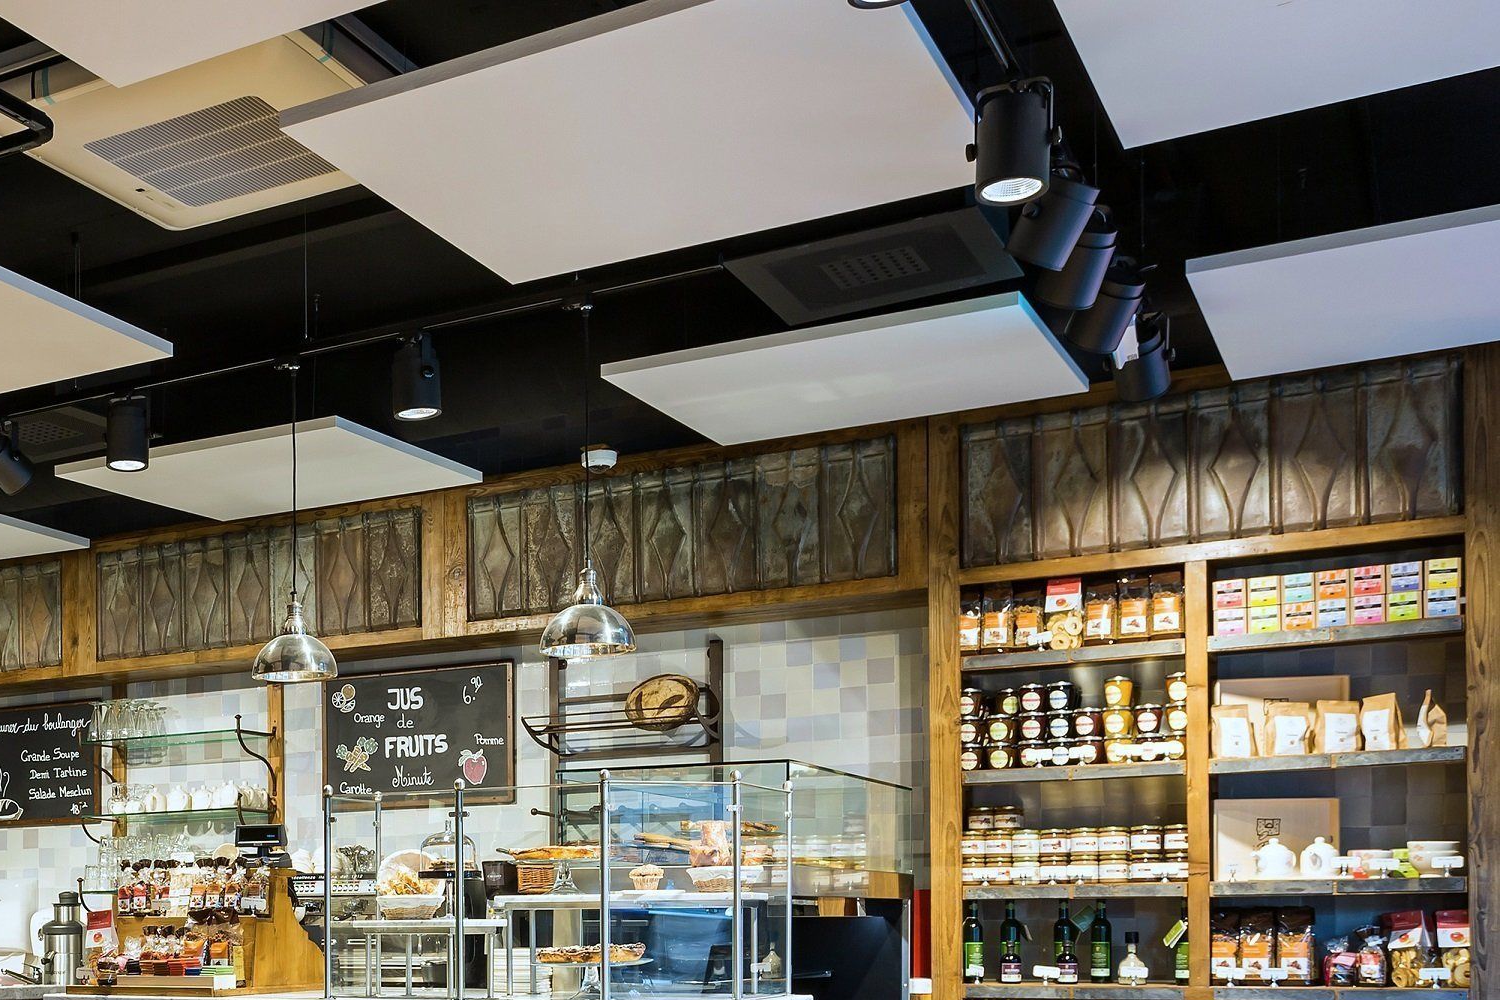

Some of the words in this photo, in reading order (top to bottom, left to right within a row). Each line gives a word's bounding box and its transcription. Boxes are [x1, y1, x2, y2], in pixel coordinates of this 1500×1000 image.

[387, 687, 424, 710] JUS
[42, 713, 91, 737] boulanger
[354, 713, 385, 728] Orange
[397, 713, 415, 729] de
[385, 734, 449, 758] FRUITS
[473, 733, 505, 746] Pomme
[21, 750, 51, 762] Grande
[53, 747, 80, 761] Soupe
[29, 769, 50, 780] Demi
[53, 766, 88, 778] Tartine
[392, 765, 434, 788] Minute
[29, 788, 56, 800] Salade
[59, 784, 92, 797] Mesclun
[339, 782, 373, 795] Carotte
